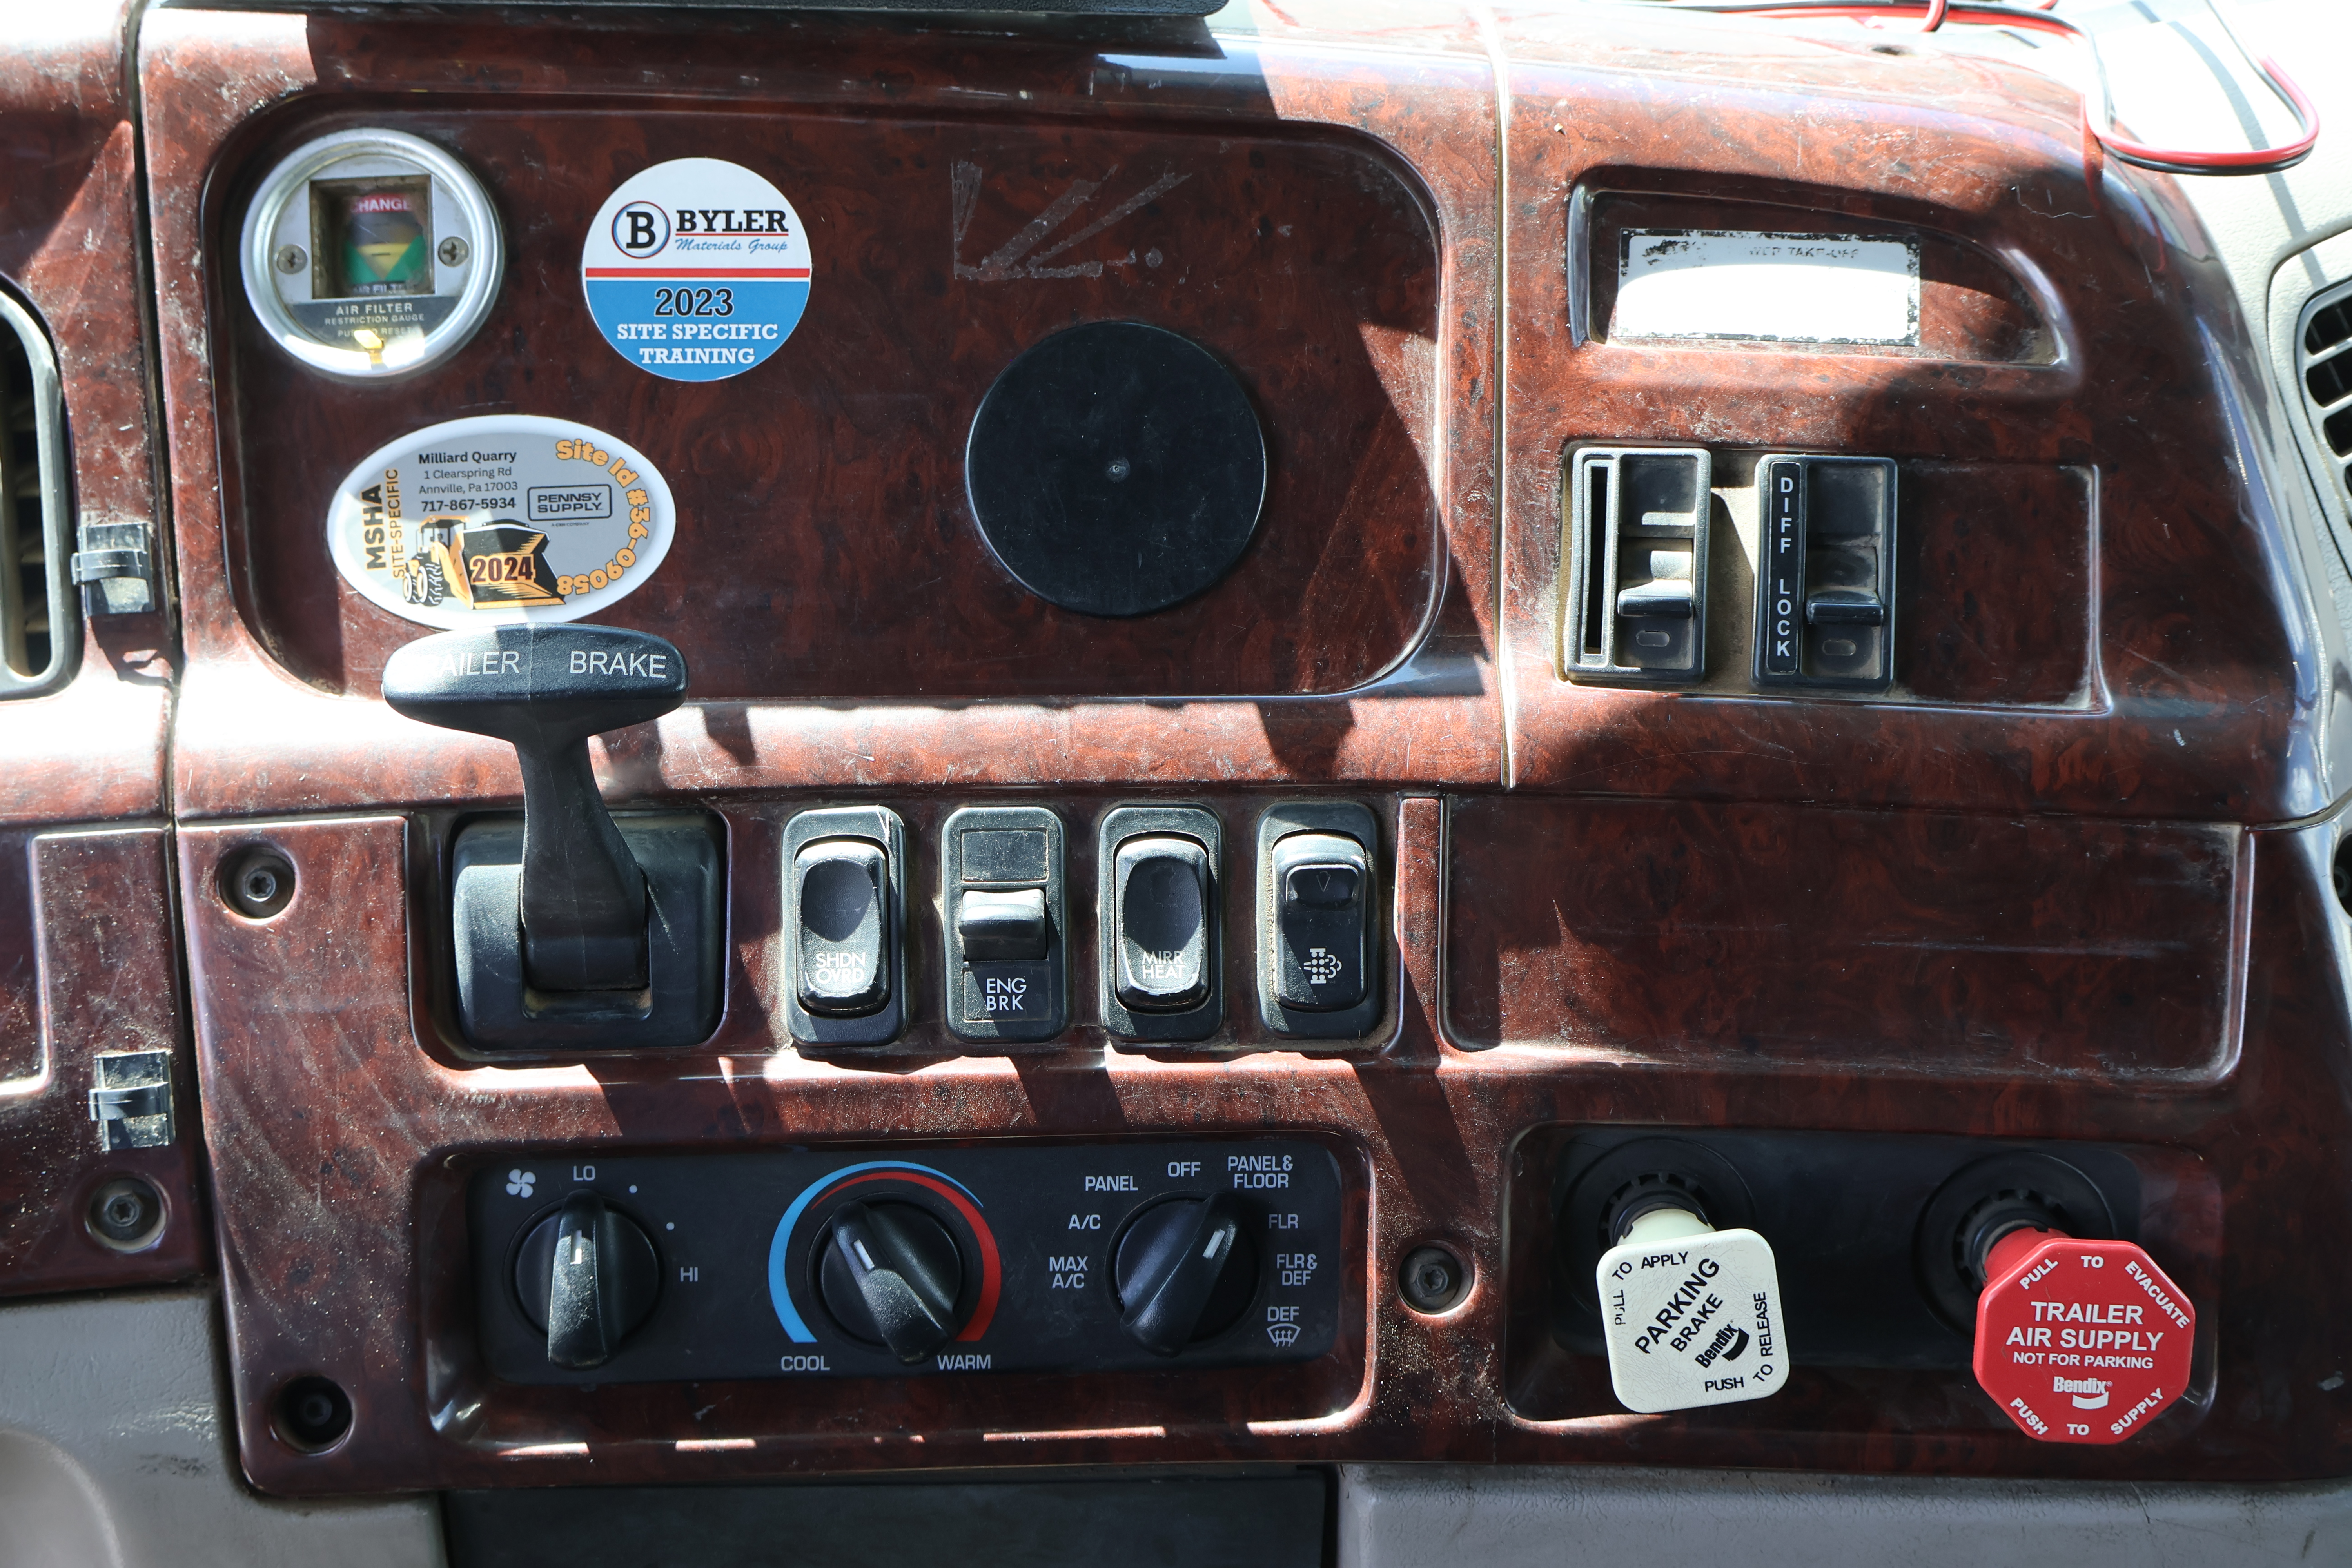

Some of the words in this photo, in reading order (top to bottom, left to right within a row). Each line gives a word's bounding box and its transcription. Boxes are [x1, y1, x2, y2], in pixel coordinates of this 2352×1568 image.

[676, 209, 789, 232] BYLER
[626, 211, 656, 249] B
[675, 238, 742, 251] Materials
[748, 238, 789, 254] Group
[336, 305, 359, 315] AIR
[365, 302, 412, 314] FILTER
[655, 287, 734, 317] 2023
[324, 316, 388, 325] RESTRICTION
[392, 313, 425, 322] GAUGE
[617, 323, 667, 340] SITE
[672, 323, 779, 340] SPECIFIC
[639, 348, 755, 365] TRAINING
[419, 452, 468, 464] Milliard
[472, 451, 517, 463] Quarry
[556, 439, 609, 466] Site
[608, 457, 640, 488] Id
[425, 470, 430, 479] 1
[433, 468, 495, 479] Clearspring
[498, 467, 511, 476] Rd
[419, 485, 465, 495] Annville,
[468, 483, 482, 492] Pa
[485, 481, 518, 491] 17003
[421, 497, 516, 512] 717-867-5934
[537, 492, 603, 503] PENNSY
[537, 502, 603, 513] SUPPLY
[1780, 477, 1794, 554] DIFF
[361, 484, 387, 570] MSHA
[386, 469, 406, 579] SITE-SPECIFIC
[472, 556, 534, 583] 2024
[1777, 579, 1792, 657] LOCK
[427, 650, 521, 677] AILER
[570, 650, 667, 679] BRAKE
[816, 952, 866, 968] SHDN
[1142, 950, 1184, 965] MIRR
[816, 967, 865, 984] OVRD
[1142, 964, 1185, 979] HEAT
[986, 977, 1027, 994] ENG
[986, 995, 1024, 1011] BRK
[573, 1165, 596, 1181] LO
[1167, 1161, 1201, 1177] OFF
[1085, 1176, 1139, 1191] PANEL
[1234, 1173, 1289, 1188] FLOOR
[1068, 1214, 1101, 1230] A/C
[1268, 1214, 1299, 1229] FLR
[1049, 1256, 1088, 1271] MAX
[1612, 1261, 1632, 1281] TO
[1641, 1251, 1689, 1269] APPLY
[680, 1267, 699, 1282] HI
[1052, 1273, 1085, 1289] A/C
[1282, 1270, 1312, 1286] DEF
[2019, 1258, 2059, 1290] PULL
[2080, 1256, 2104, 1269] TO
[2124, 1260, 2190, 1329] EVACUATE
[1267, 1306, 1299, 1322] DEF
[1634, 1258, 1720, 1354] PARKING
[2030, 1301, 2143, 1325] TRAILER
[1670, 1293, 1724, 1352] BRAKE
[1753, 1292, 1773, 1357] RELEASE
[1694, 1323, 1739, 1368] Bendix
[2005, 1327, 2052, 1347] AIR
[2060, 1328, 2164, 1352] SUPPLY
[780, 1355, 831, 1372] COOL
[937, 1354, 991, 1370] WARM
[2013, 1352, 2045, 1365] NOT
[2049, 1353, 2080, 1366] FOR
[2084, 1355, 2154, 1369] PARKING
[1753, 1363, 1773, 1382] TO
[1704, 1376, 1744, 1392] PUSH
[2053, 1376, 2107, 1394] Bendix
[2009, 1397, 2049, 1436] PUSH
[2067, 1423, 2090, 1436] TO
[2110, 1387, 2165, 1435] SUPPLY
